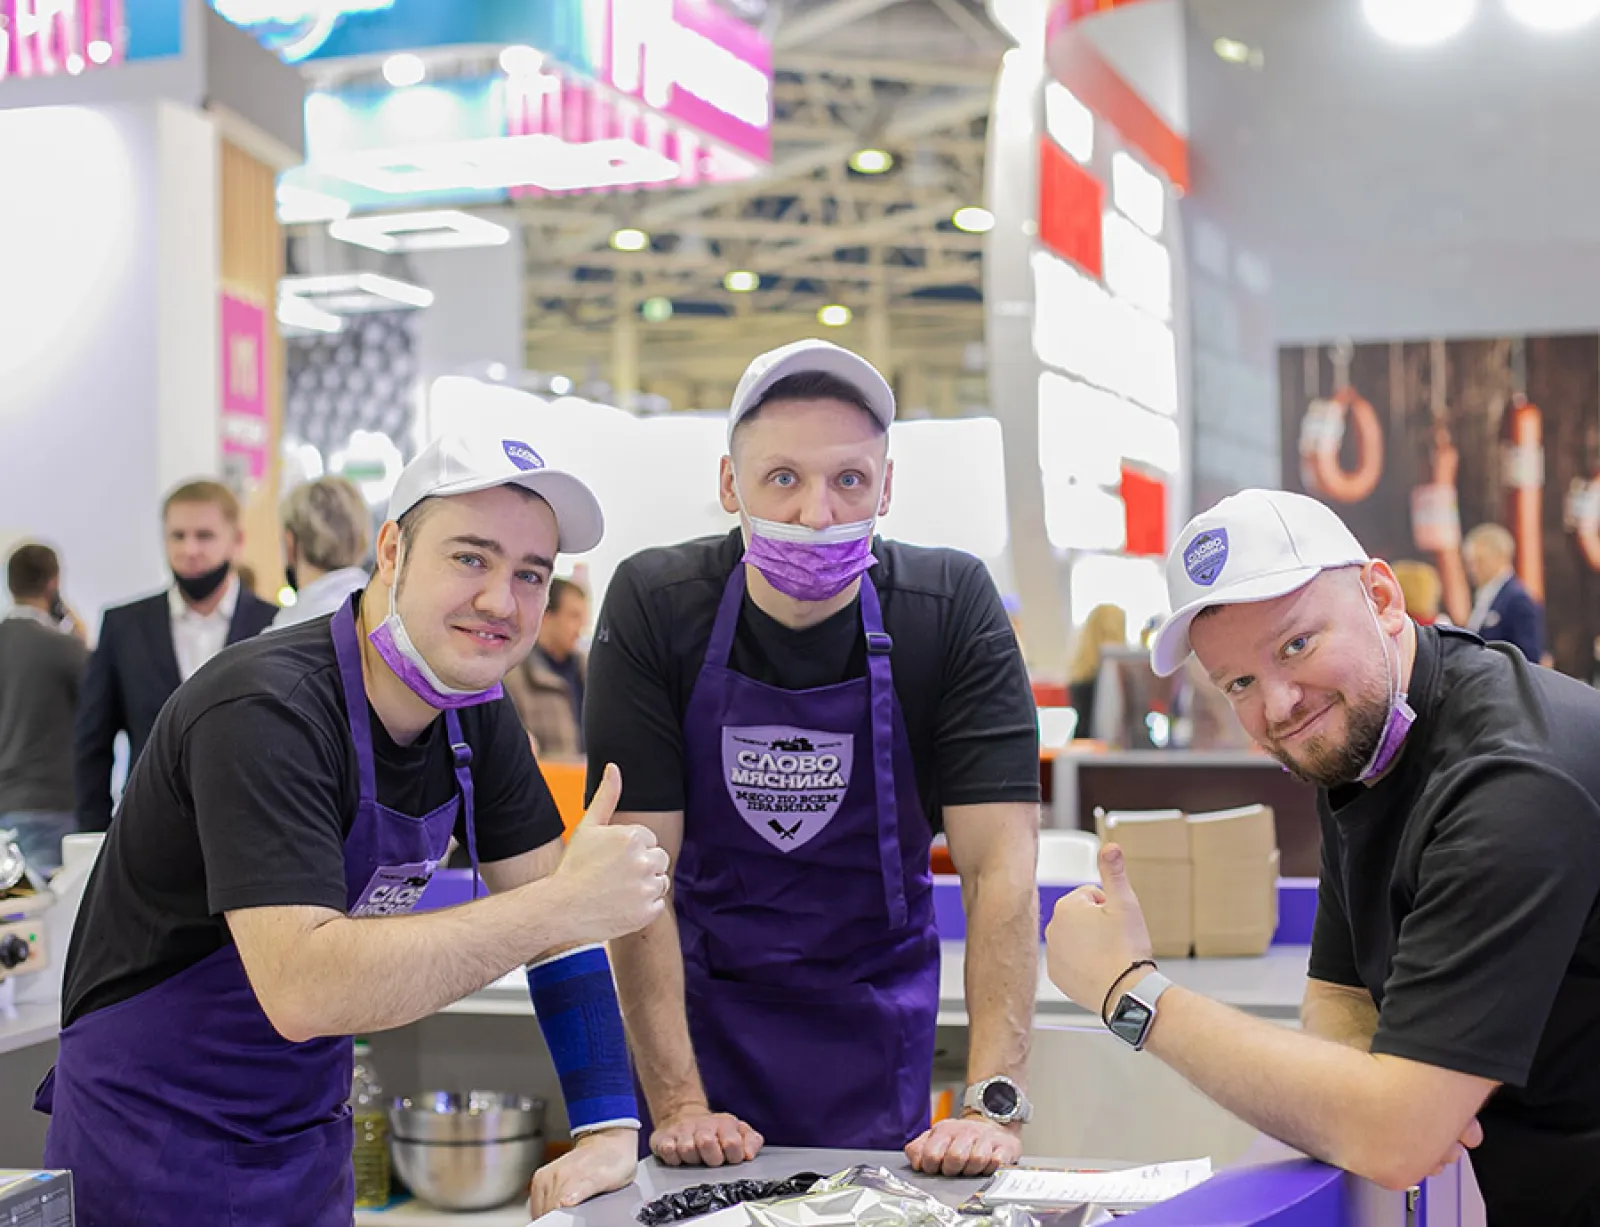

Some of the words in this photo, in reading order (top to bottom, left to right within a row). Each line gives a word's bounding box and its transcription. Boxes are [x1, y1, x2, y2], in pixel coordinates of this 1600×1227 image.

[737, 750, 840, 773] СЛОВО
[731, 767, 846, 790] МЯСНИКА
[735, 790, 775, 803] МЯСО
[777, 793, 797, 803] ПО
[799, 794, 838, 803] ВСЕМ
